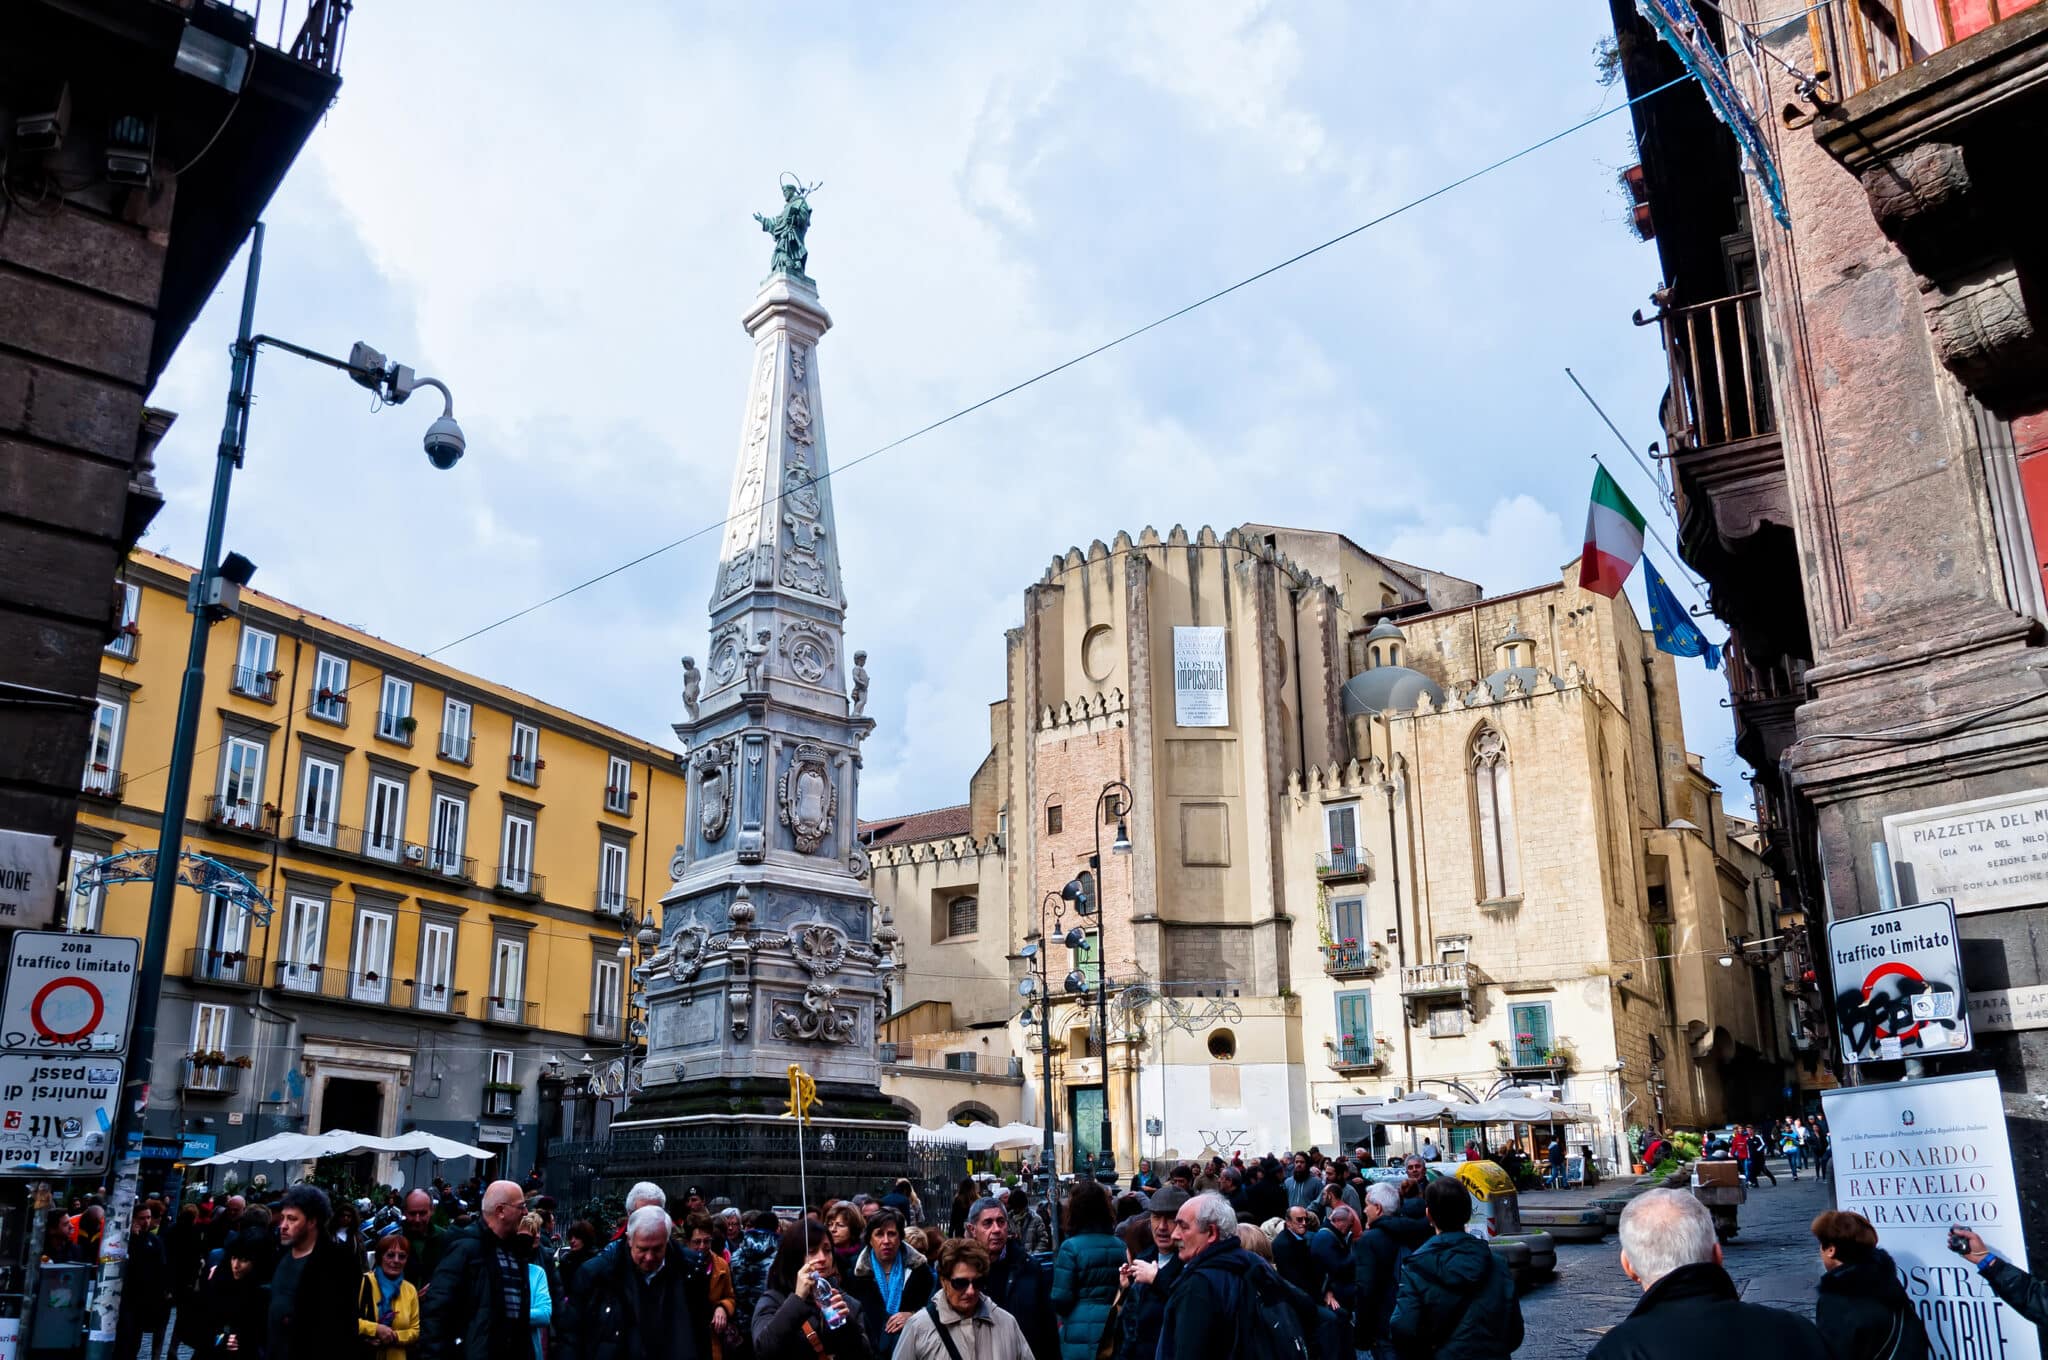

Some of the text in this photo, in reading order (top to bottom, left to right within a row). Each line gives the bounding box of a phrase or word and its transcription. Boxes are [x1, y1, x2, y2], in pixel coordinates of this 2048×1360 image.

[1177, 661, 1223, 669] MOSTRA
[1177, 669, 1224, 690] IMPOSSIBILE
[1914, 819, 1995, 843] PIAZZETTA
[2000, 814, 2029, 828] DEL
[1968, 844, 1983, 853] VIA
[1994, 840, 2011, 848] DEL
[1987, 855, 2027, 868] SEZIONE
[1963, 881, 1983, 890] CON
[2002, 872, 2042, 885] SEZIONE
[1871, 921, 1901, 937] zona
[61, 942, 92, 953] zona
[1837, 932, 1949, 964] traffico limitato
[17, 955, 131, 972] traffico limitato
[33, 1066, 86, 1082] passi
[4, 1085, 108, 1102] munirsi di
[50, 1150, 104, 1166] Polizia
[1851, 1144, 1977, 1170] LEONARDO
[1850, 1173, 1986, 1197] RAFFAELLO
